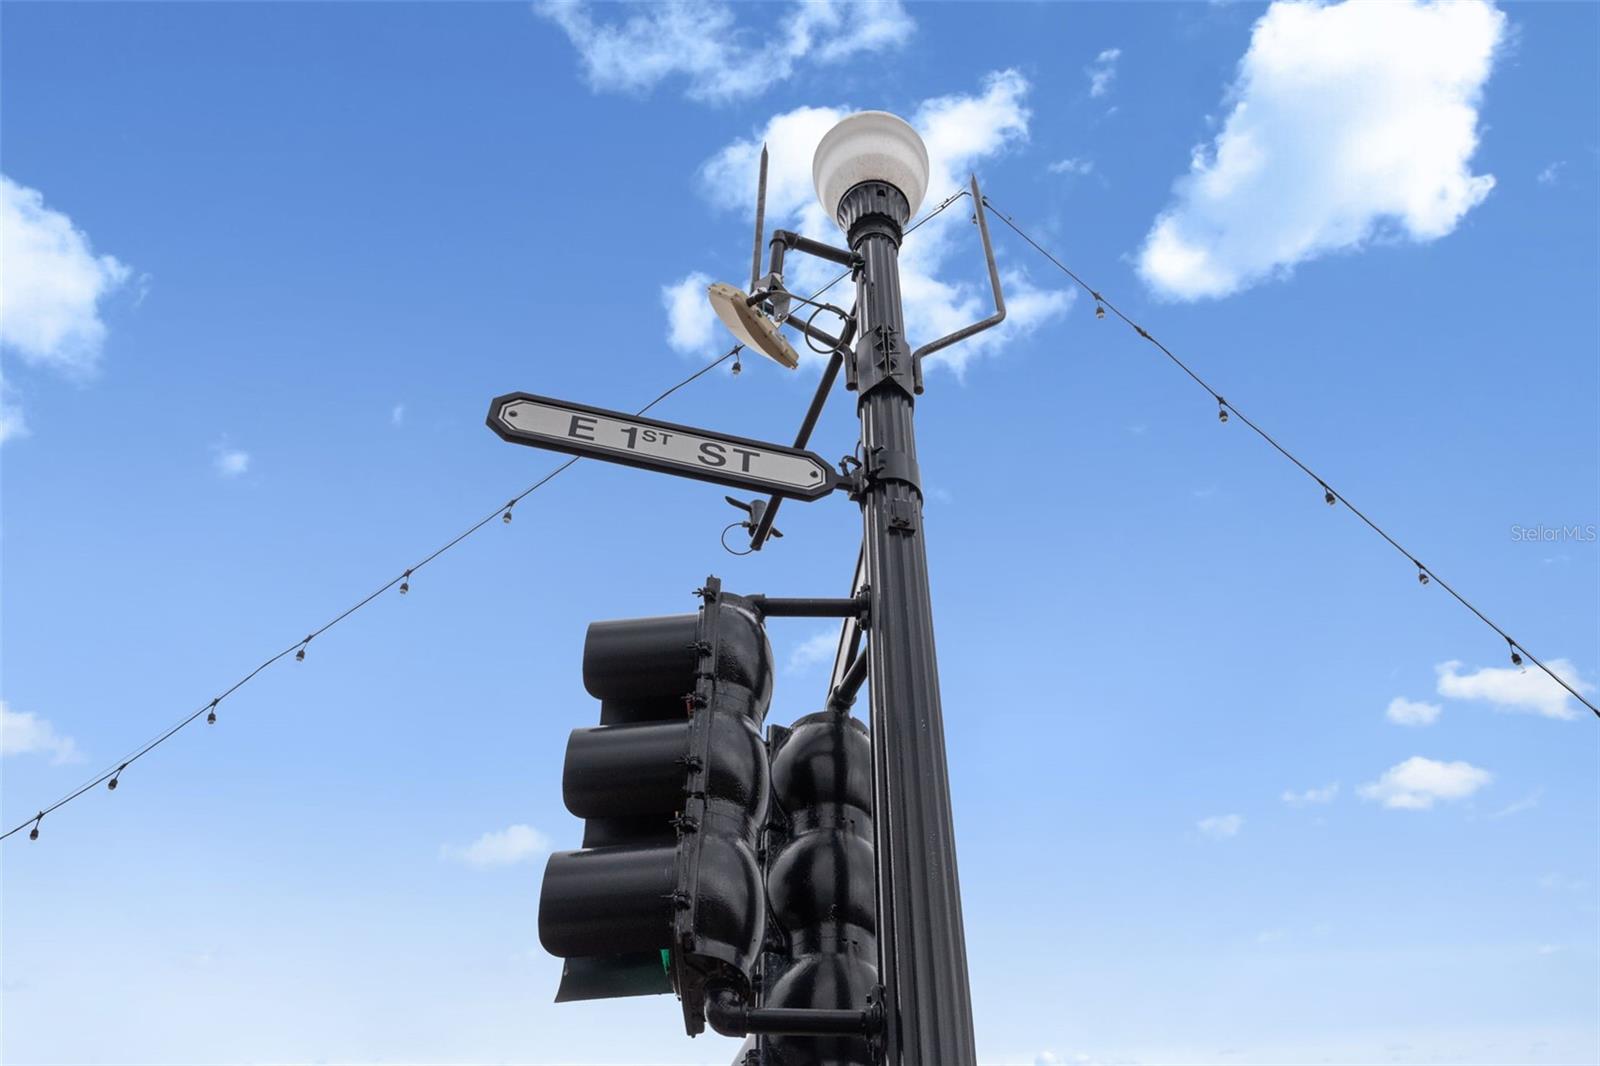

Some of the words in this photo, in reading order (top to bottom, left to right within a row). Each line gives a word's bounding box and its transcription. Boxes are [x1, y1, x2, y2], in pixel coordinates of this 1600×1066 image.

[568, 415, 598, 441] E
[620, 427, 673, 449] 1ST
[697, 442, 760, 473] ST
